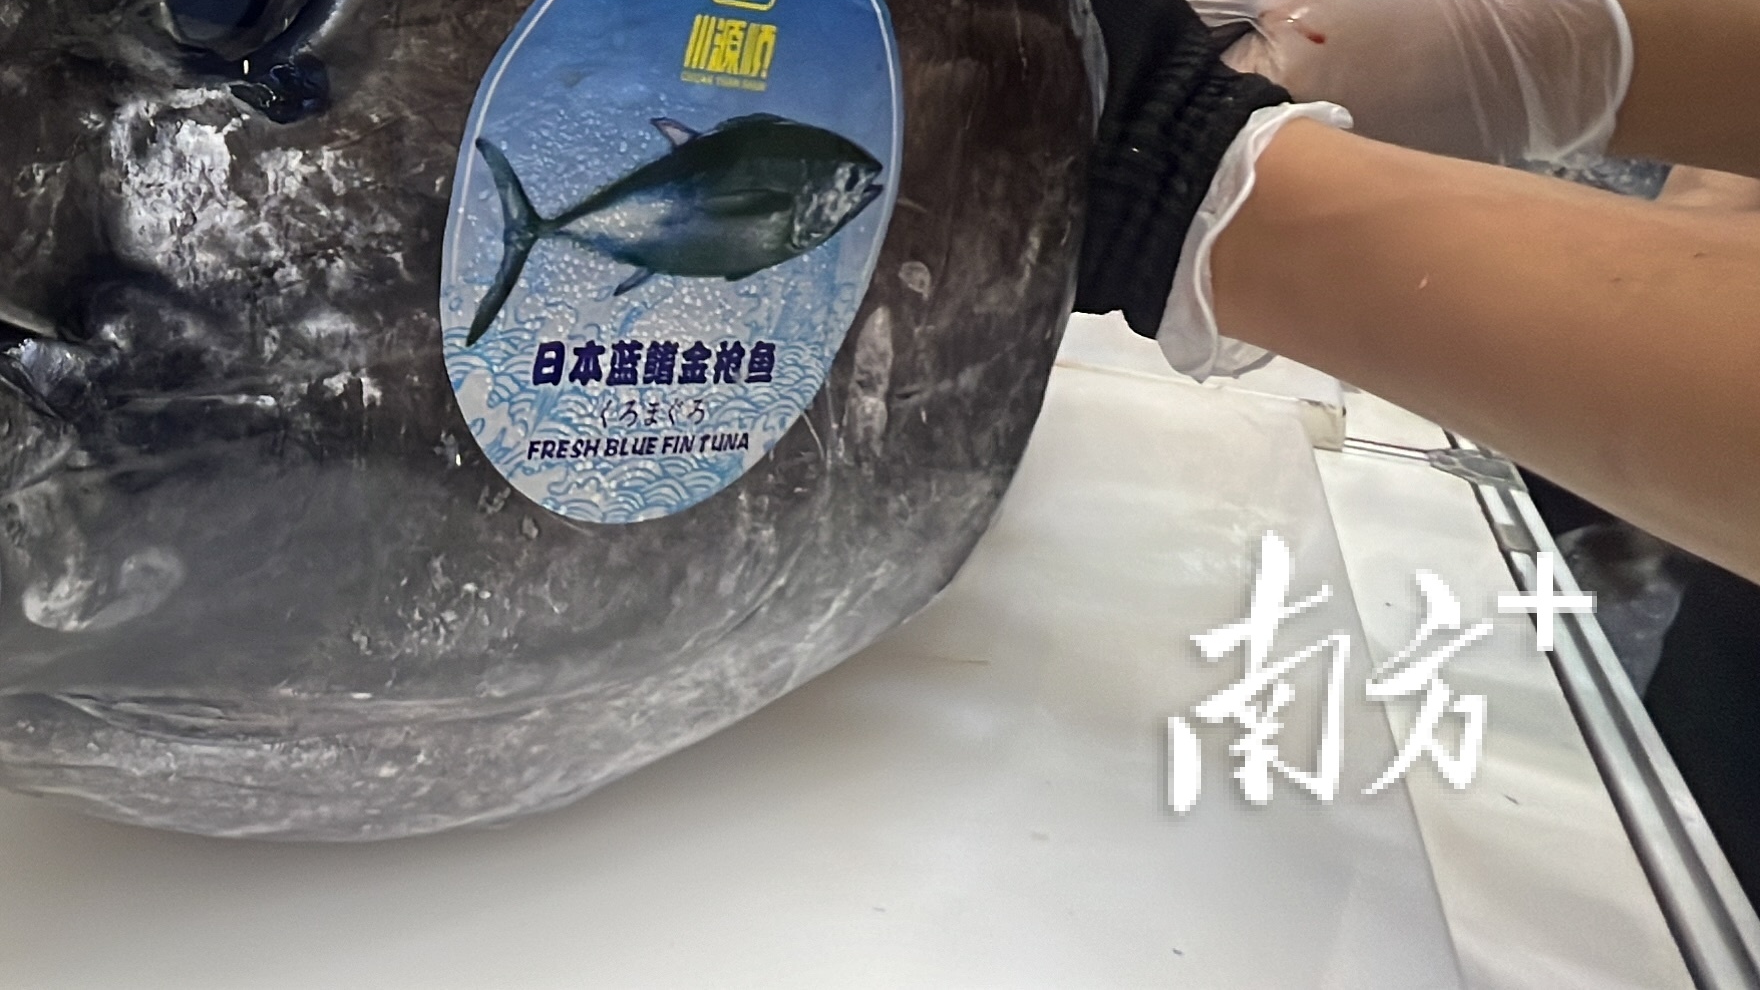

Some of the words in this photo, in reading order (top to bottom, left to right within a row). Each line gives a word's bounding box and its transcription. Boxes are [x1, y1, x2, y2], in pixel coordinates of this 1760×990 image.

[532, 340, 776, 386] 日本蓝鳍金枪鱼
[600, 398, 705, 429] くろまぐろ
[527, 438, 601, 460] FRESH
[604, 436, 658, 457] BLUE
[661, 433, 694, 455] FIN
[698, 432, 749, 452] TUNA
